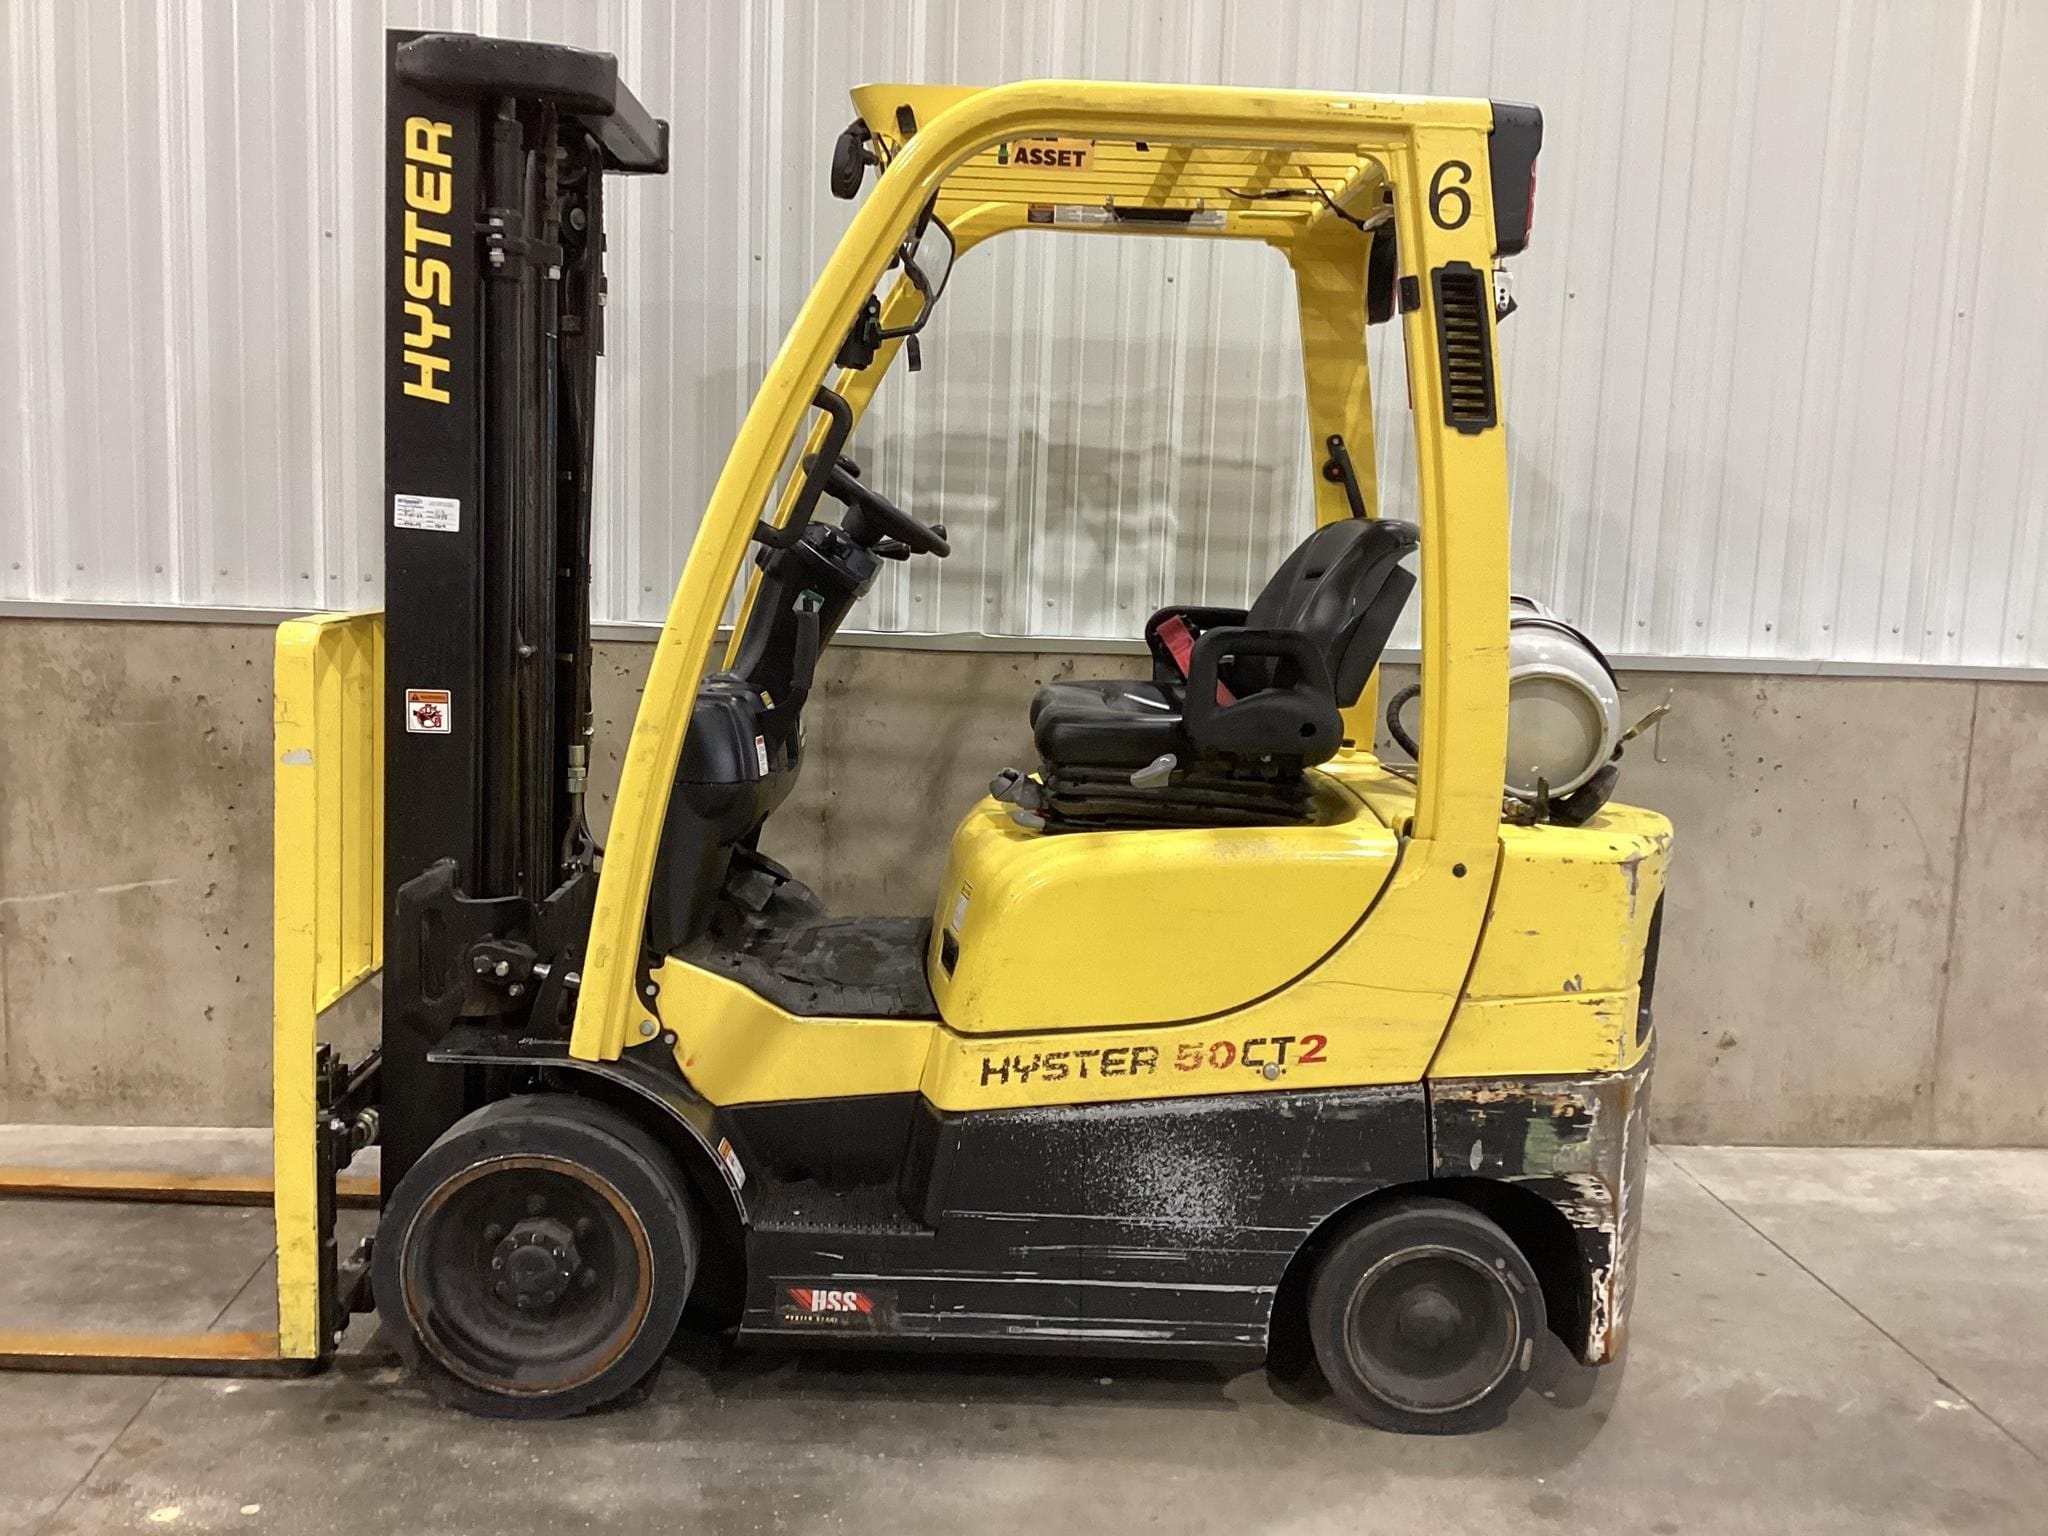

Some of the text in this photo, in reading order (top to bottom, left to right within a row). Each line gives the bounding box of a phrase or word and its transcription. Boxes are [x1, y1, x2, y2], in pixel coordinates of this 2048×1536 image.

[1014, 147, 1087, 167] ASSET
[1428, 159, 1473, 231] 6
[403, 115, 454, 405] HYSTER
[980, 1045, 1160, 1087] HYSTER
[811, 1289, 858, 1312] HSS
